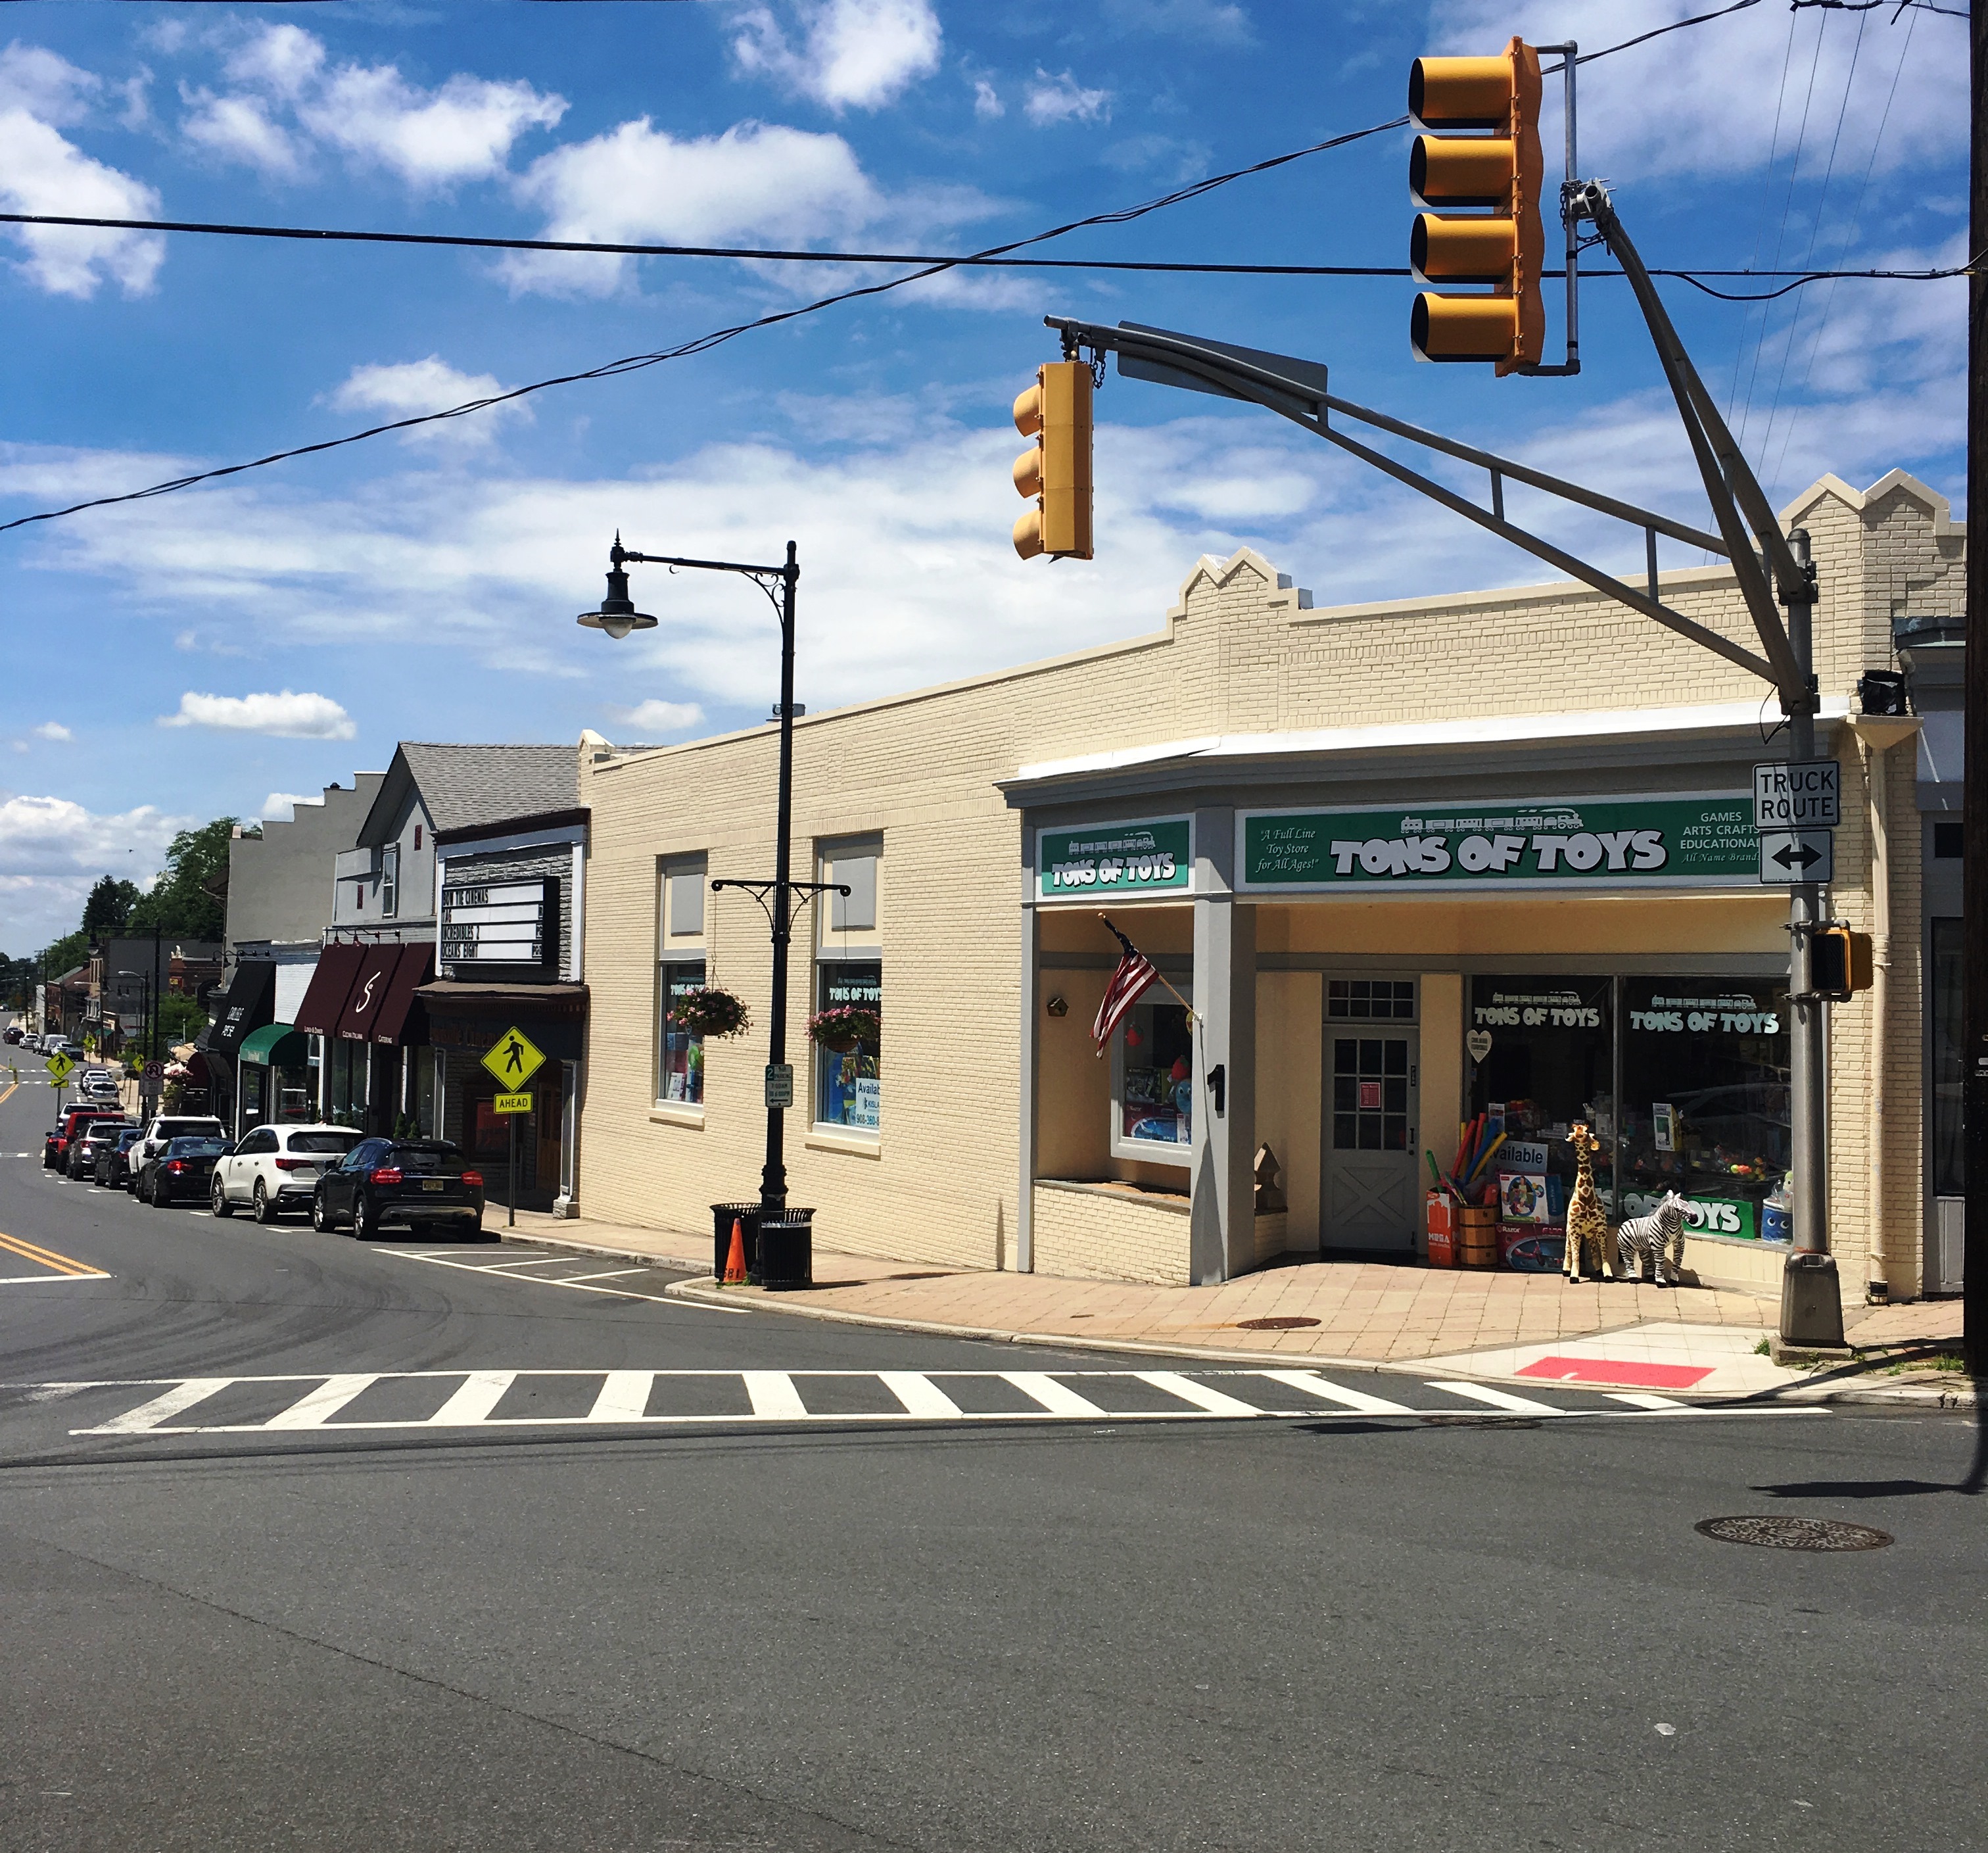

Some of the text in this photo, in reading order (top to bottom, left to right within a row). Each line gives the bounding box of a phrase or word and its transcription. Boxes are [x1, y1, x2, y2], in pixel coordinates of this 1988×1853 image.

[1760, 770, 1835, 793] TRUCK
[1761, 796, 1834, 819] ROUTE
[1701, 811, 1742, 822] GAMES
[1273, 827, 1293, 839] Full
[1294, 827, 1316, 838] Line
[1682, 826, 1712, 836] ARTS
[1266, 843, 1310, 857] Toy Store
[1330, 829, 1668, 878] TONS OF TOYS
[1255, 858, 1272, 873] for
[1271, 859, 1289, 871] All
[1682, 853, 1696, 863] All
[1053, 852, 1177, 888] TONS OF TOYS
[829, 986, 850, 1001] TONS
[851, 987, 863, 1001] OF
[1475, 1006, 1599, 1027] TONS OF TOYS
[1630, 1011, 1780, 1034] TONS OF TOYS
[767, 1067, 774, 1078] 2
[858, 1082, 880, 1095] Availab
[500, 1098, 528, 1108] AHEAD
[1490, 1146, 1543, 1165] vailable
[1687, 1200, 1741, 1233] OYS
